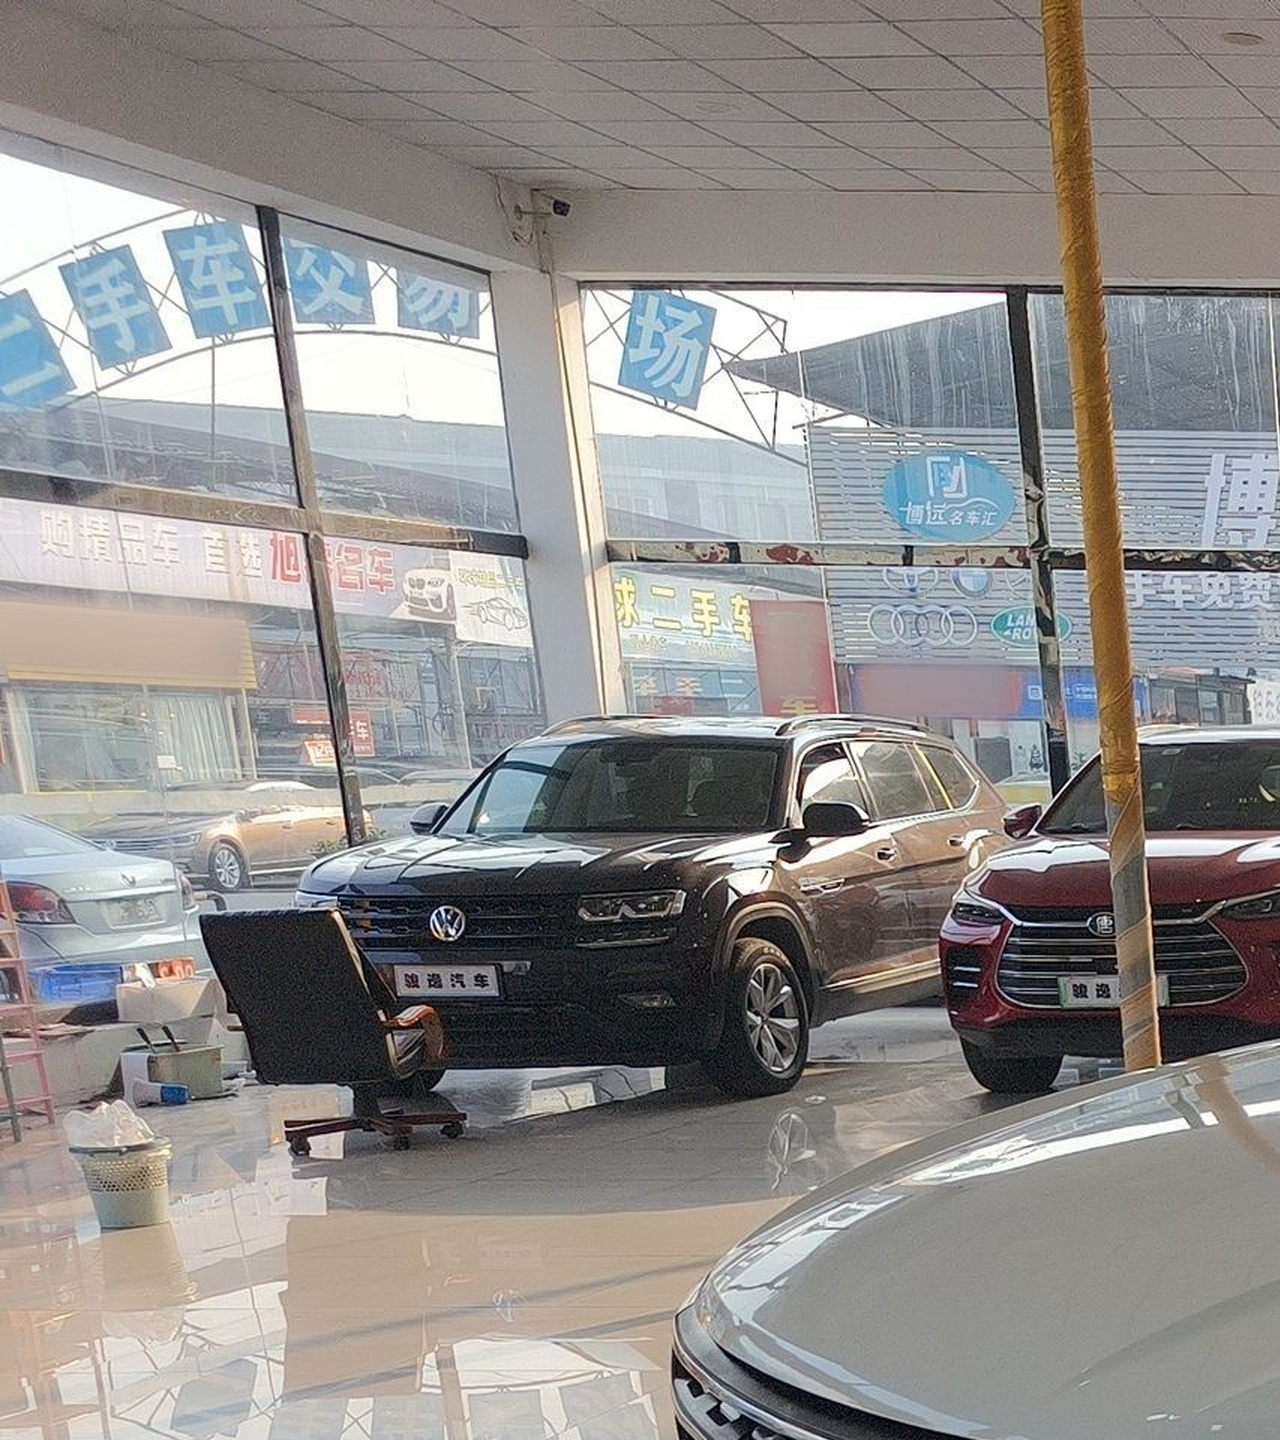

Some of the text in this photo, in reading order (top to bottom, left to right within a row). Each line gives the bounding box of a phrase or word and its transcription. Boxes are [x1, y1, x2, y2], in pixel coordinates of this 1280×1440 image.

[899, 501, 998, 526] 博远名车汇
